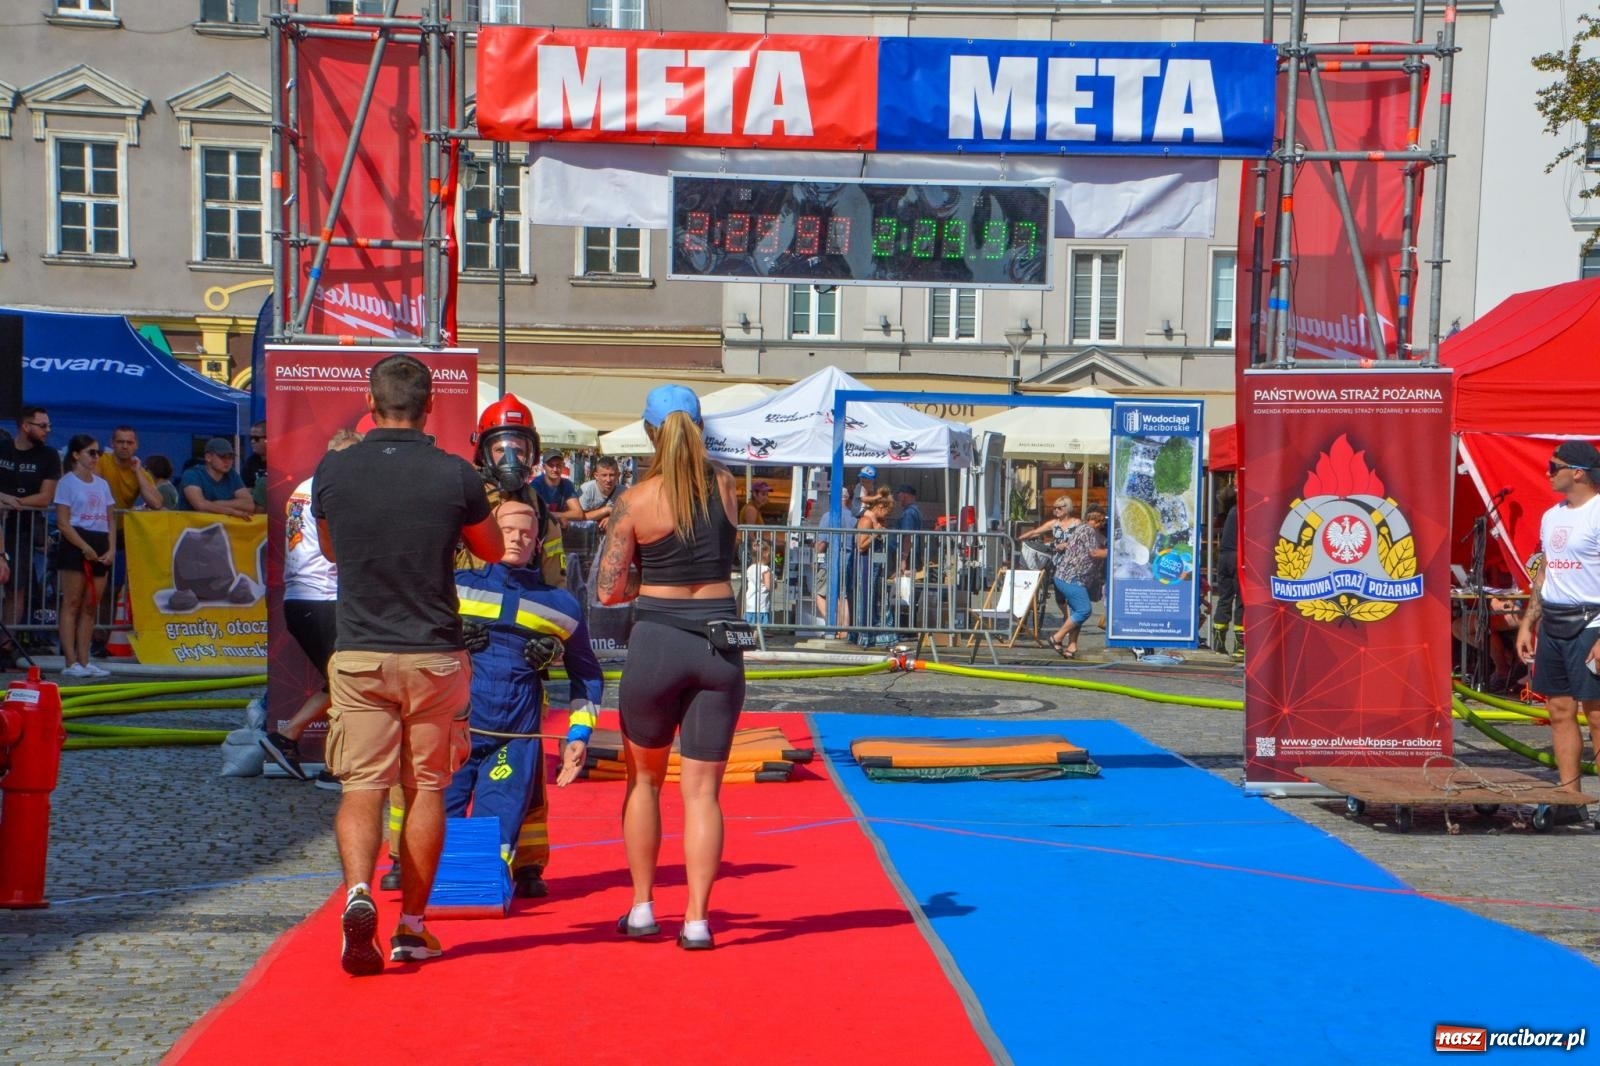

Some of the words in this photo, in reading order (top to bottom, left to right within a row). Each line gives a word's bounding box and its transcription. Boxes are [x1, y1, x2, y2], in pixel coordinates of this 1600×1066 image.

[537, 44, 814, 137] META
[948, 55, 1224, 143] META
[871, 217, 1038, 260] 2:29.97
[276, 363, 362, 379] PAŃSTWOWA
[428, 366, 468, 380] ARNA
[1254, 387, 1337, 400] PAŃSTWOWA
[1340, 387, 1380, 400] STRAŻ
[1382, 386, 1442, 400] POŻARNA
[1316, 407, 1353, 415] PAŃSTWOWEJ
[1375, 407, 1403, 415] POŻARNEJ
[1142, 415, 1190, 425] Wodociągi
[845, 442, 866, 451] Mad
[1546, 559, 1582, 569] cibórz
[1274, 579, 1331, 598] PAŃSTWOWA
[1334, 573, 1363, 589] STRAŻ
[1368, 580, 1419, 597] POŻARNA
[166, 618, 223, 640] granity,
[174, 643, 217, 661] płyty
[1281, 736, 1442, 748] www.gov.pl/web/kppsp-raciborz
